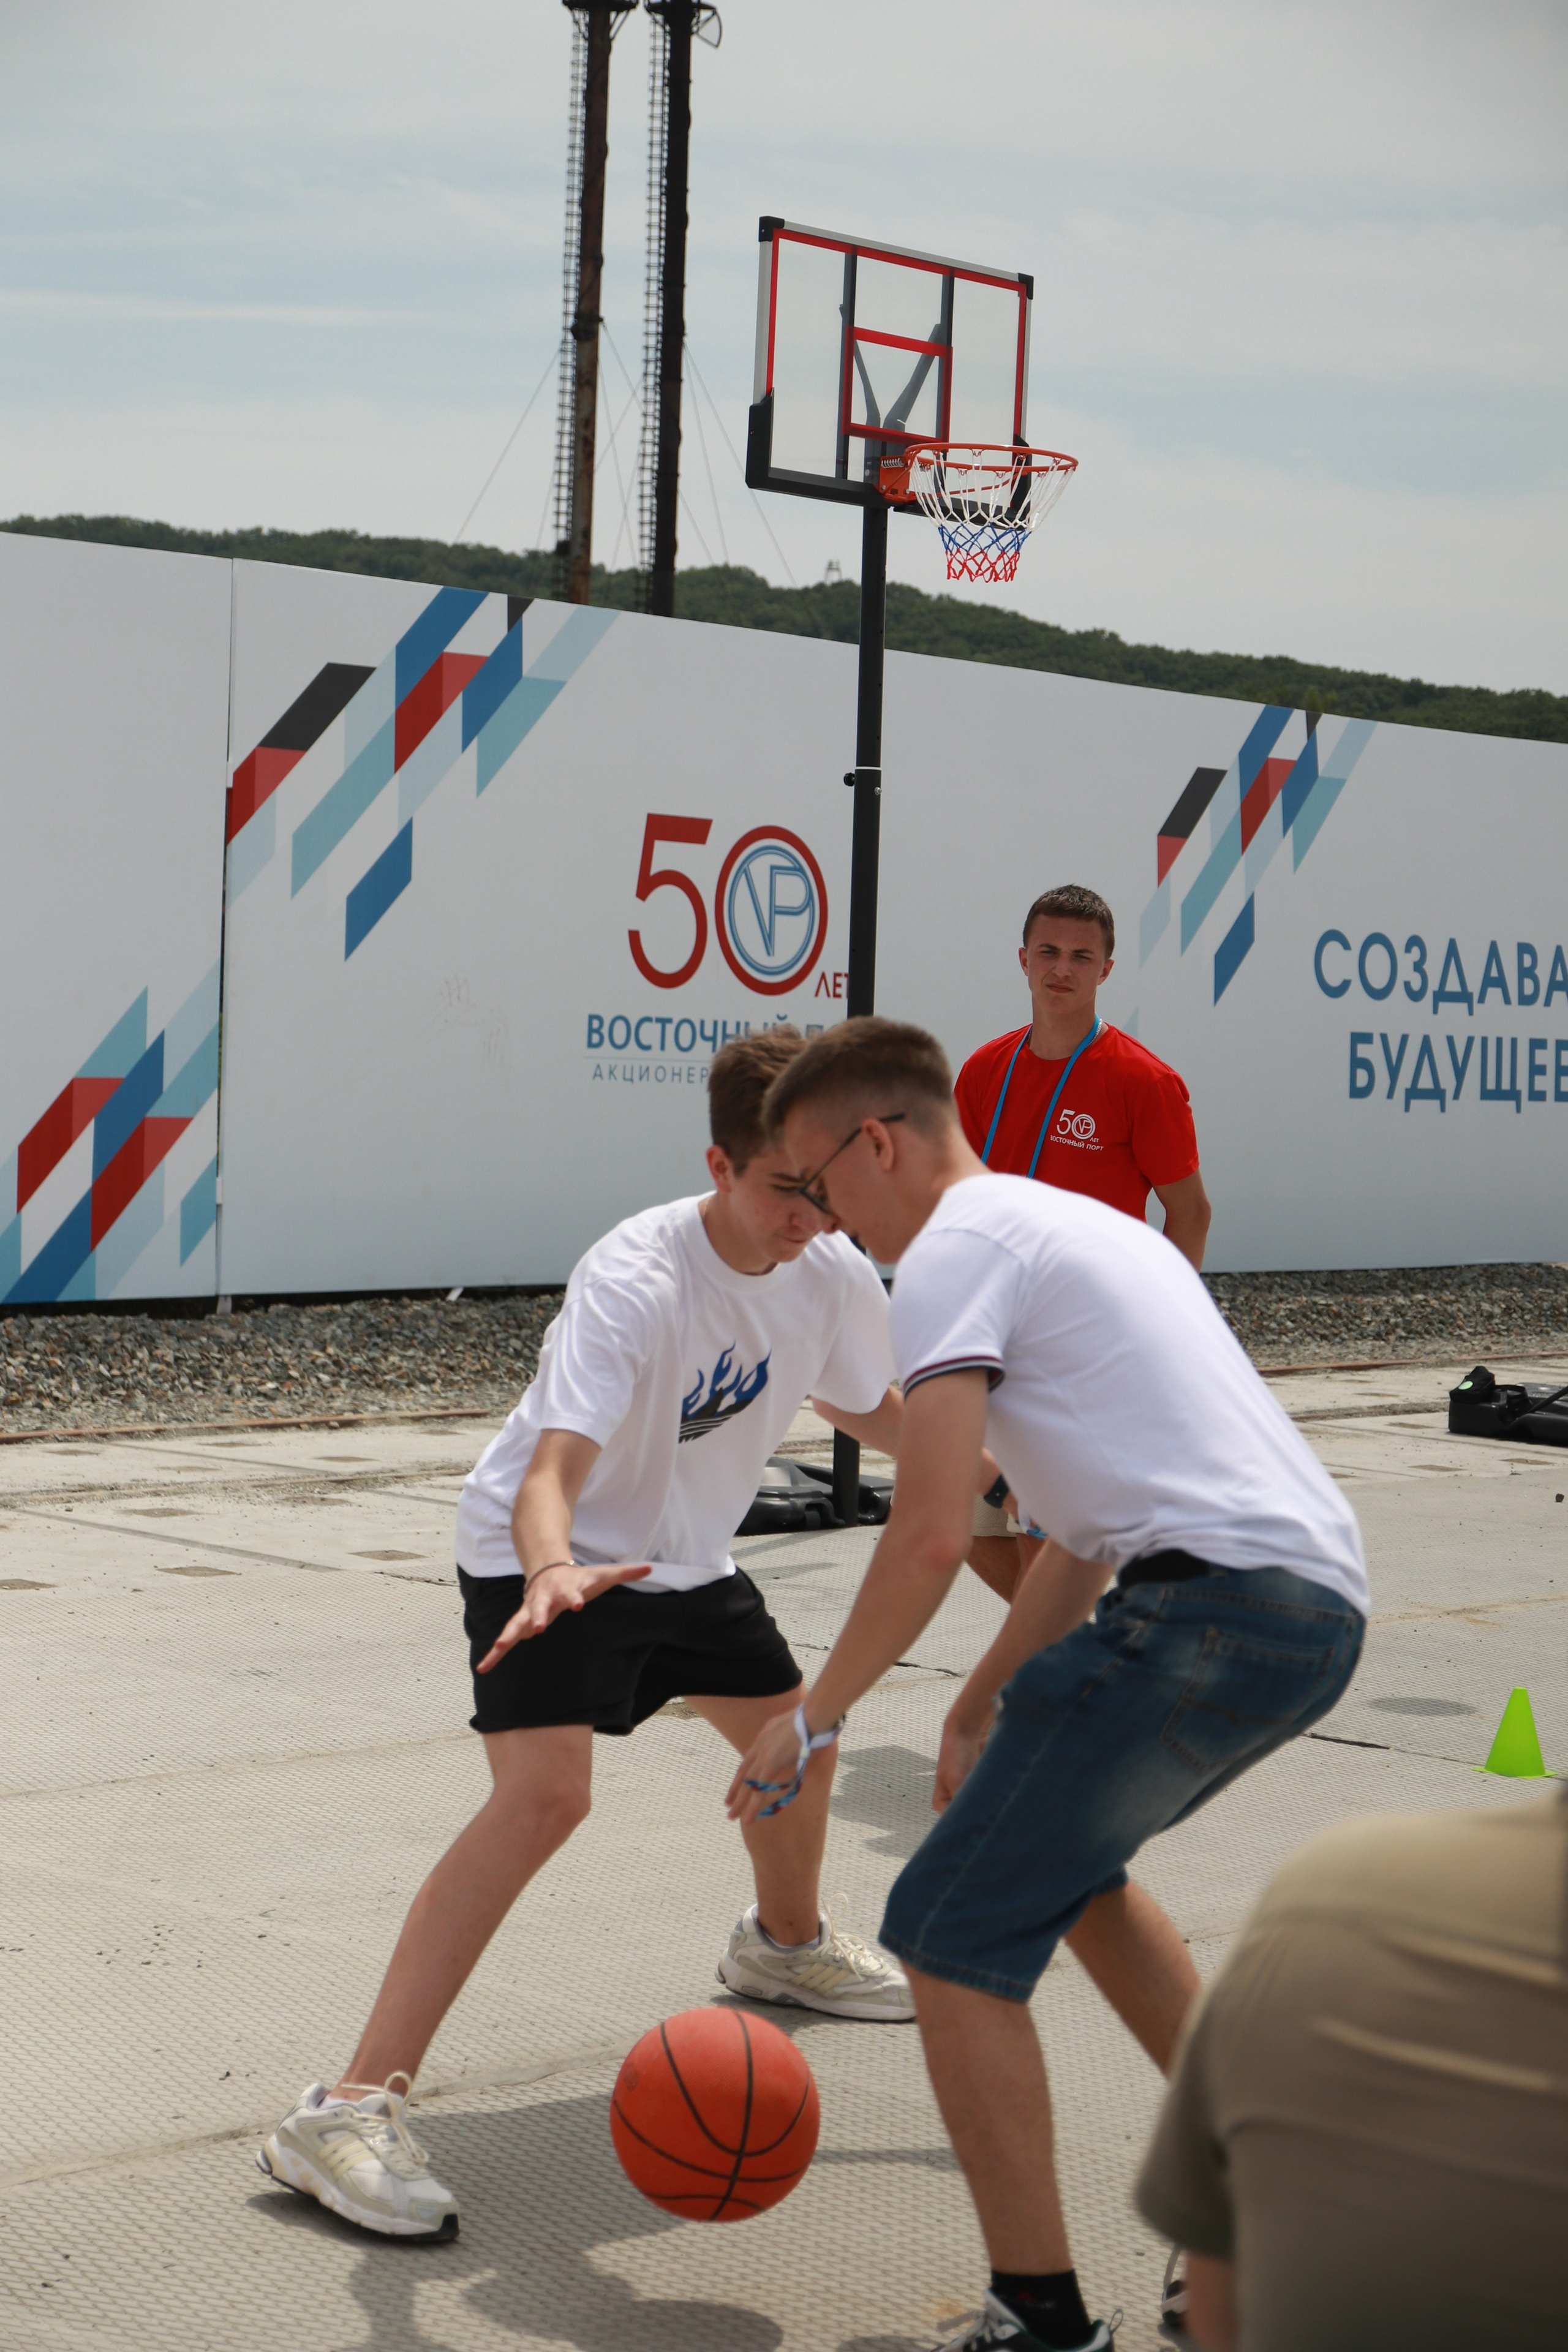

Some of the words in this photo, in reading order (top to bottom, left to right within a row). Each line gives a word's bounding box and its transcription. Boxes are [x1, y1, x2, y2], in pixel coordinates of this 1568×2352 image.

[628, 812, 829, 997] 50
[1314, 929, 1568, 1016] СОЗДАВА
[586, 1013, 792, 1054] ВОСТОЧН
[1349, 1031, 1568, 1114] БУДУЩЕЕ
[1050, 1135, 1085, 1148] ВОСТОЧНЫЙ
[1057, 1109, 1095, 1139] 50
